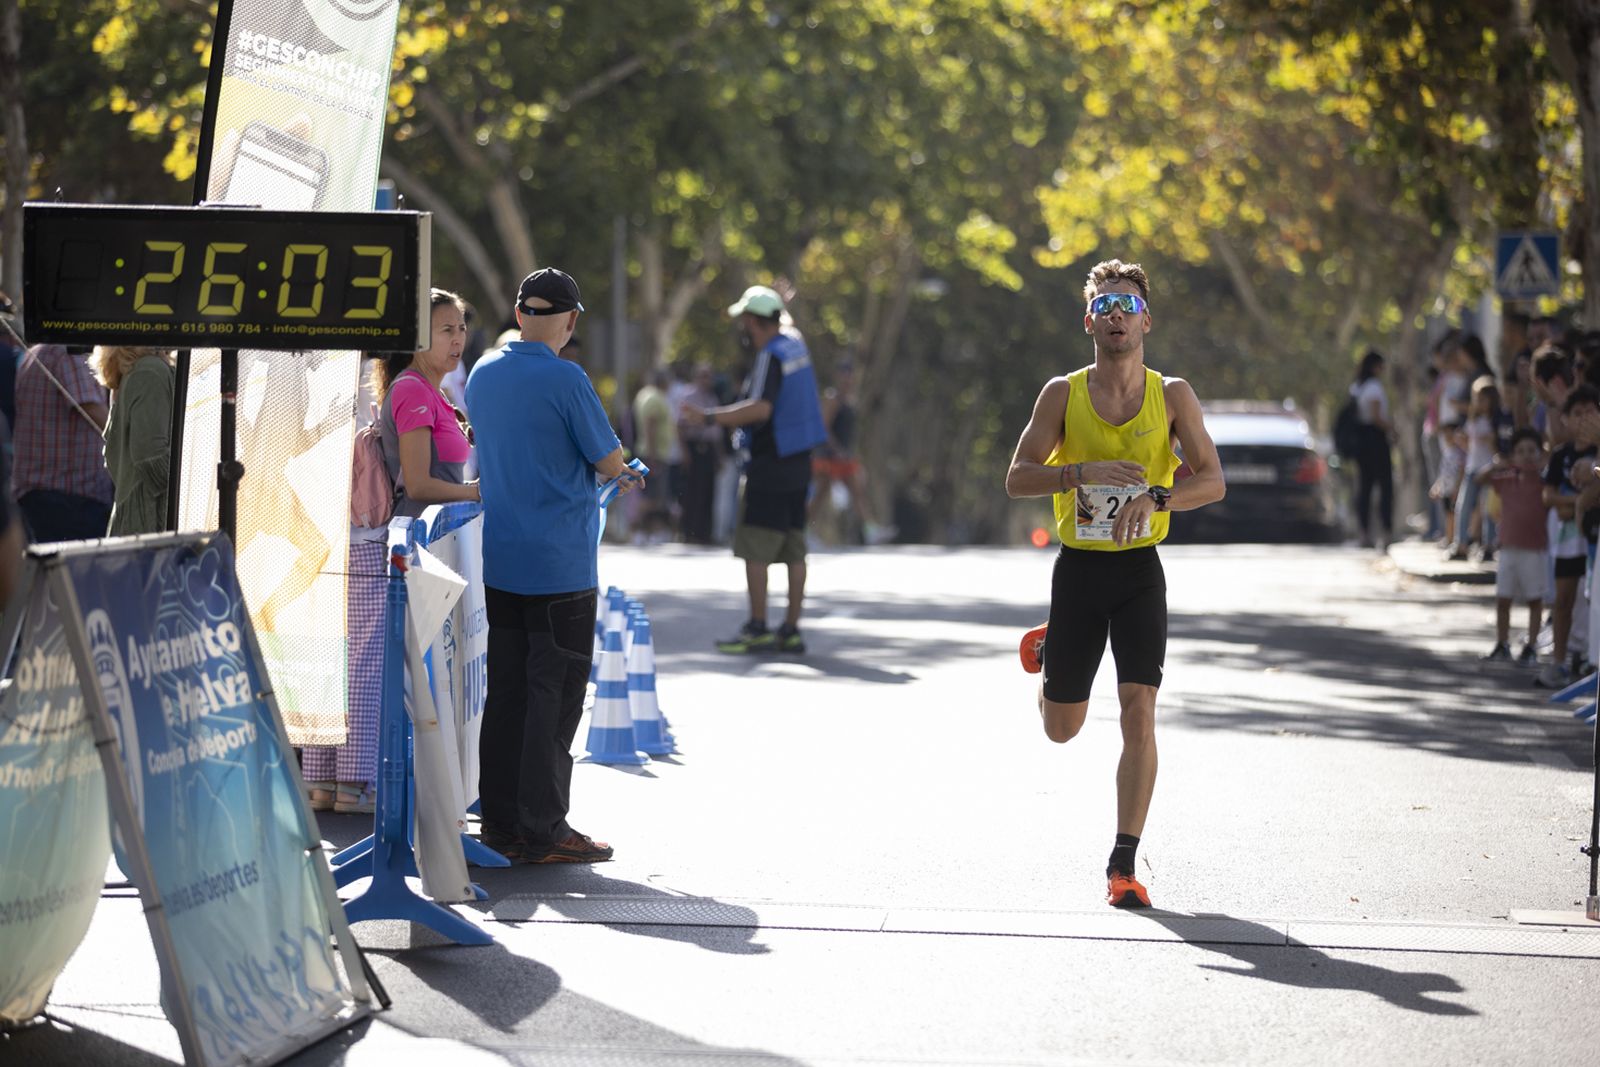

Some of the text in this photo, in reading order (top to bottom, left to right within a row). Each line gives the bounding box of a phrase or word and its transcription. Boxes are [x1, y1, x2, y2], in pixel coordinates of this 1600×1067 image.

[237, 28, 381, 91] #GESCONCHIP
[42, 319, 170, 333] www.gesconchip.es
[209, 323, 234, 333] 980
[237, 323, 261, 334] 784
[273, 323, 400, 336] info@gesconchip.es
